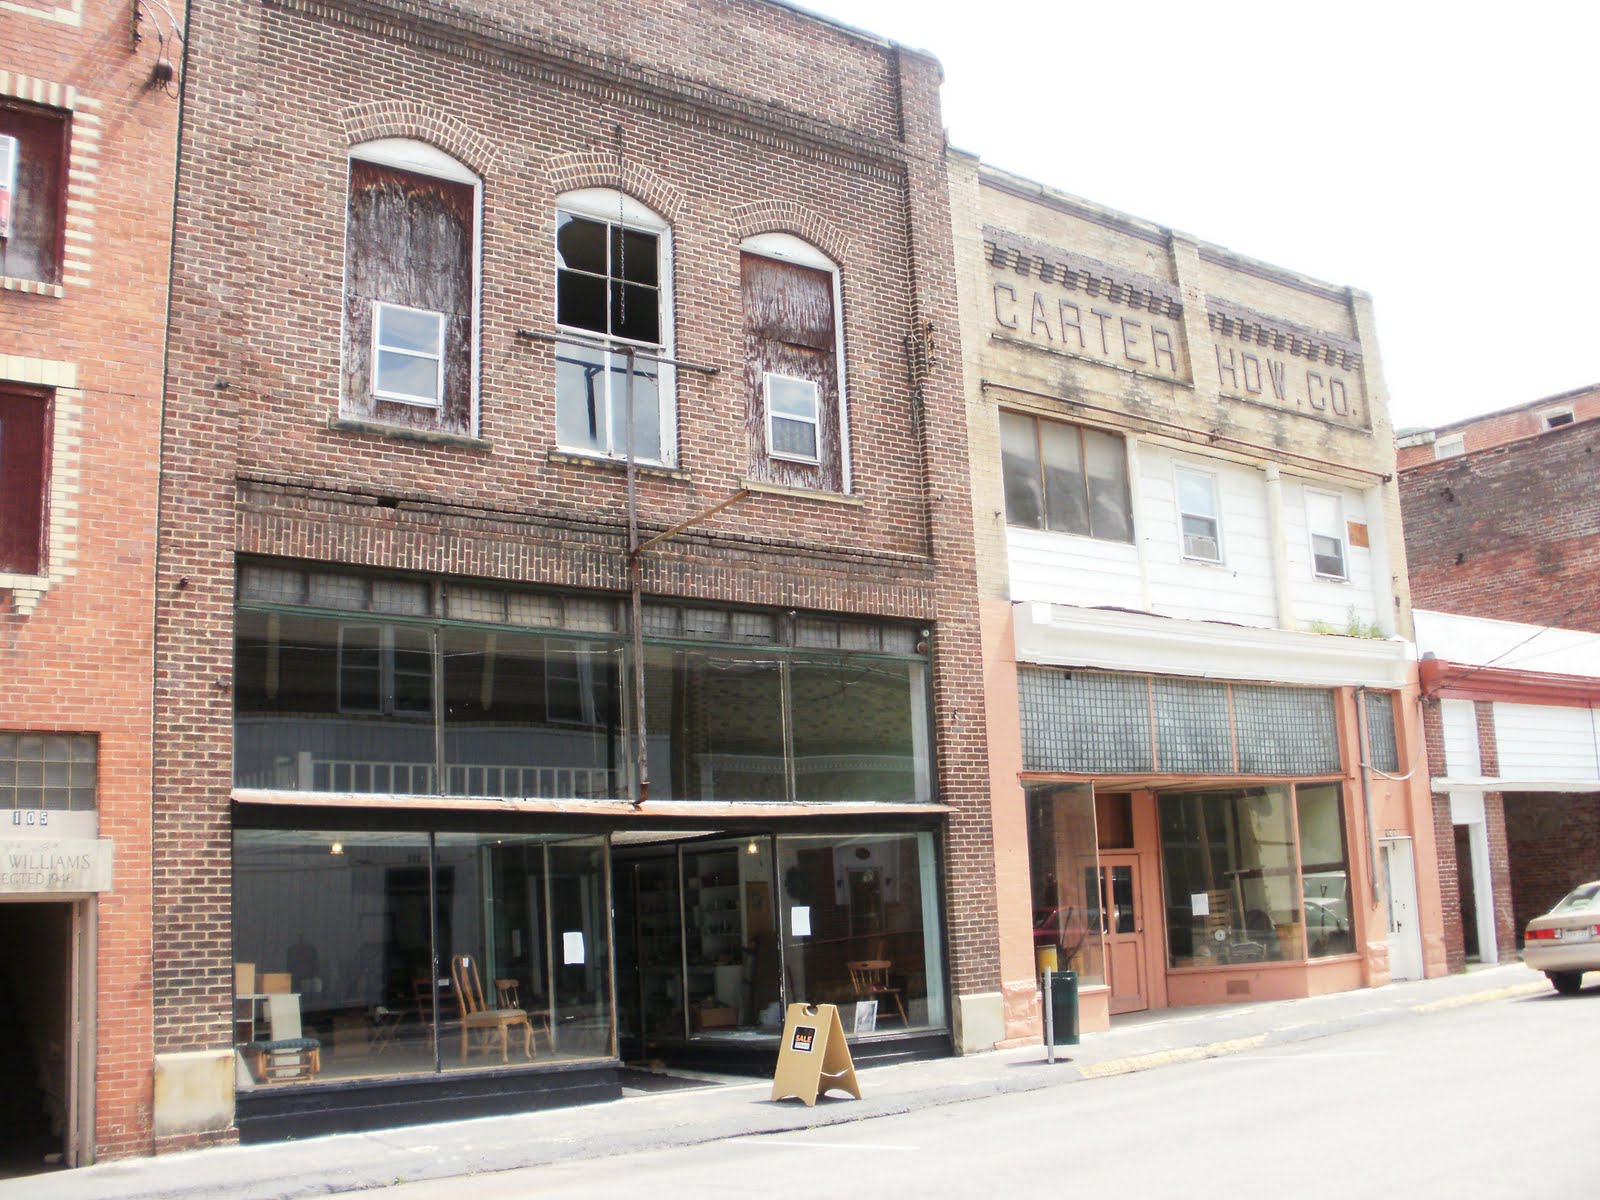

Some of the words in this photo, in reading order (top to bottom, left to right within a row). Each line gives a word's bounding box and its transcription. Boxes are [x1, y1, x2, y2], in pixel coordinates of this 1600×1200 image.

[993, 281, 1177, 372] CARTER
[1306, 369, 1358, 417] CO.
[12, 811, 48, 826] 105
[9, 854, 91, 870] WILLIAMS
[796, 1034, 813, 1043] SALE
